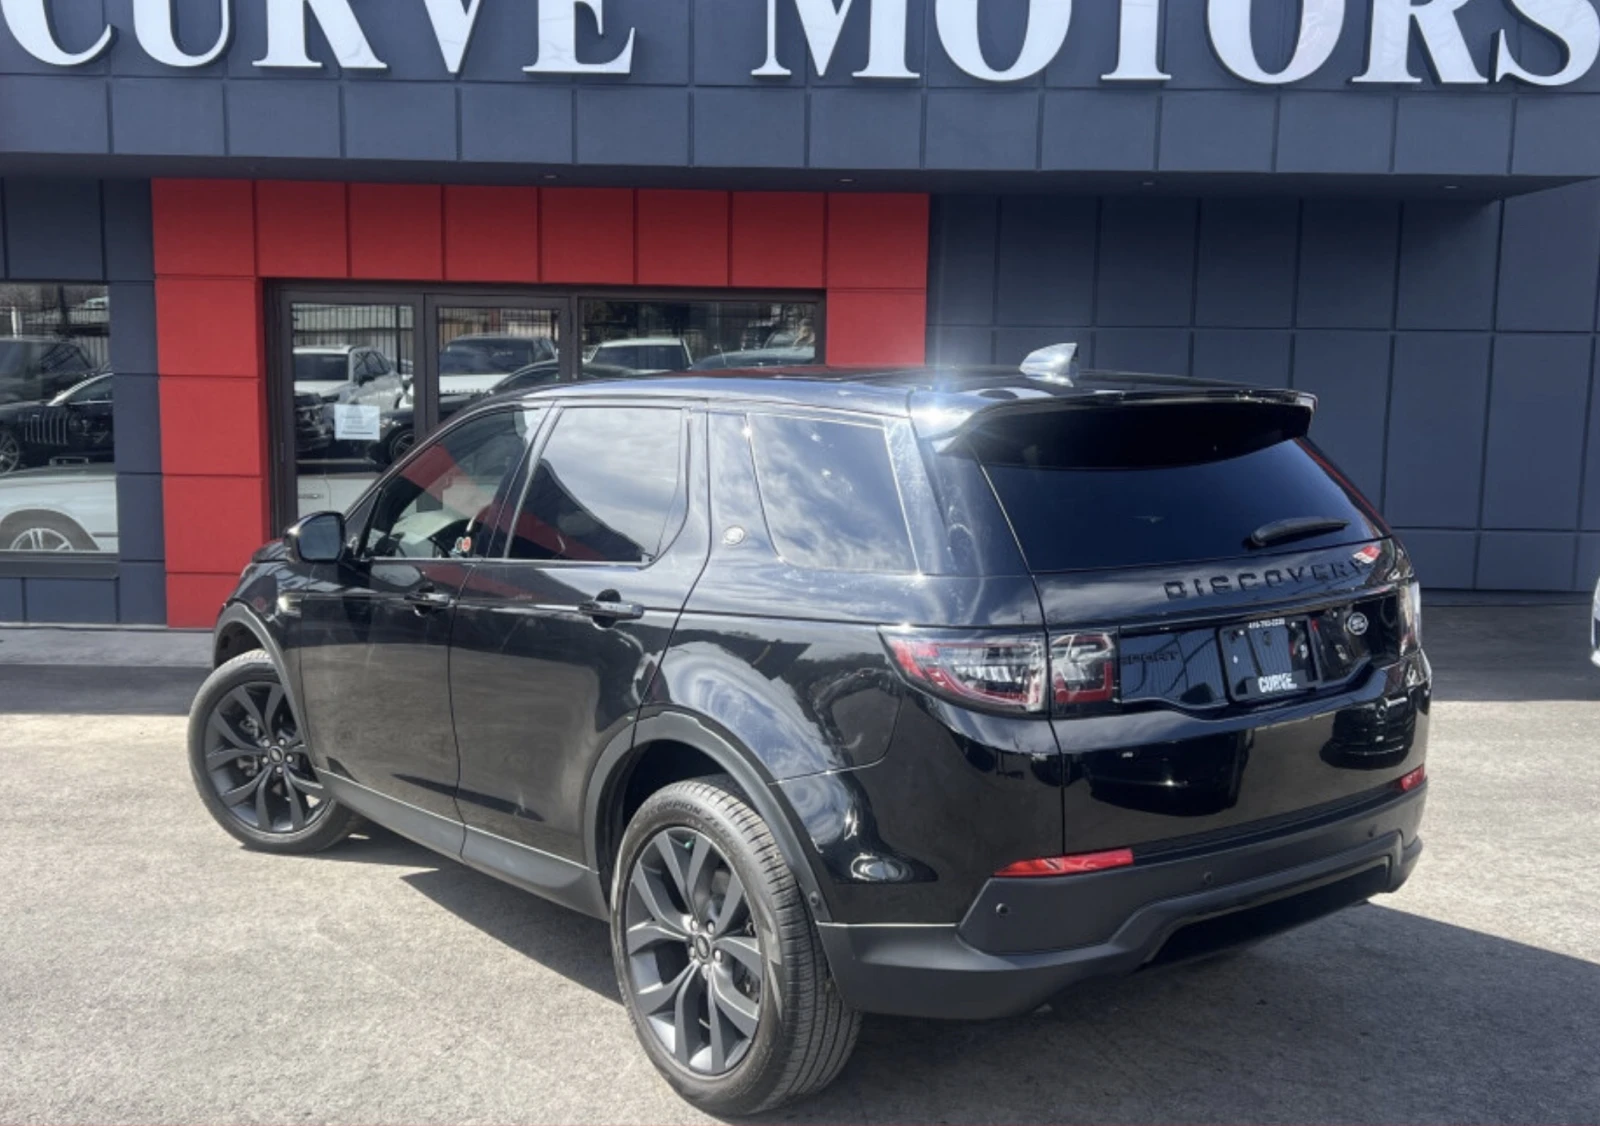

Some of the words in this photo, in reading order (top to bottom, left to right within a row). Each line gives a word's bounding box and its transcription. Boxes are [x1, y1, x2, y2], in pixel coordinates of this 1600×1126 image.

[751, 0, 1600, 86] MOTORS
[1164, 559, 1363, 600] DISCOVERY
[1258, 673, 1297, 692] CURVE
